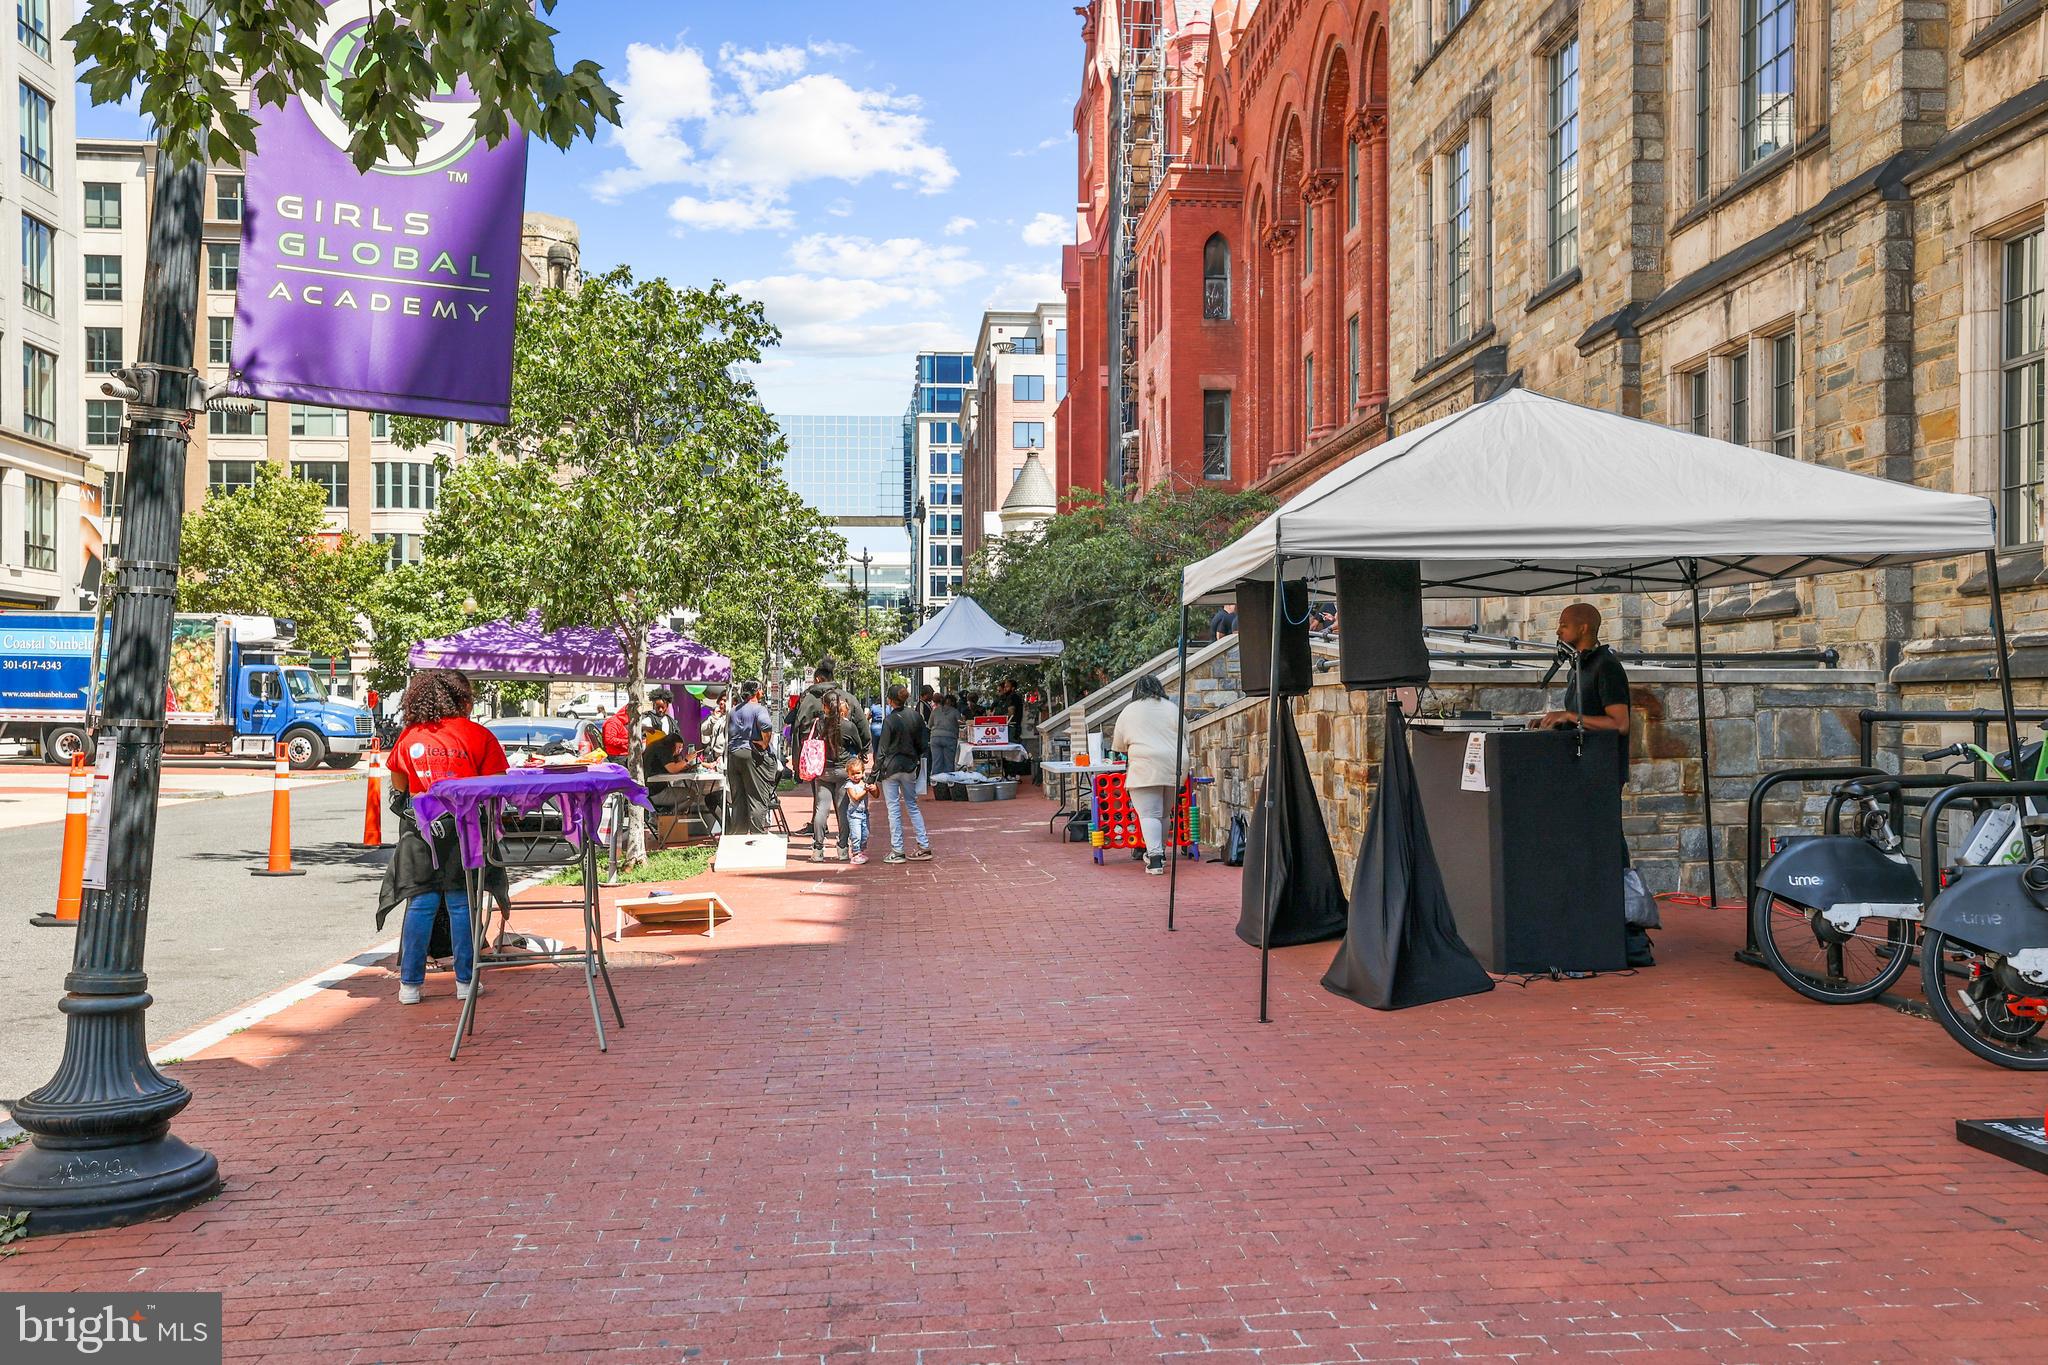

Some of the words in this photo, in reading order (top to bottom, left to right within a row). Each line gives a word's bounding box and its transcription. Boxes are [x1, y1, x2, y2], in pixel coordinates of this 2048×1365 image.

[276, 195, 430, 236] GIRLS
[278, 232, 491, 279] GLOBAL
[268, 282, 489, 322] ACADEMY
[3, 634, 45, 649] Coastal
[49, 635, 93, 650] Sunbelt
[3, 660, 62, 670] 301-617-4343
[2, 690, 78, 699] www.coastalsunbelt.com
[985, 727, 997, 735] 60
